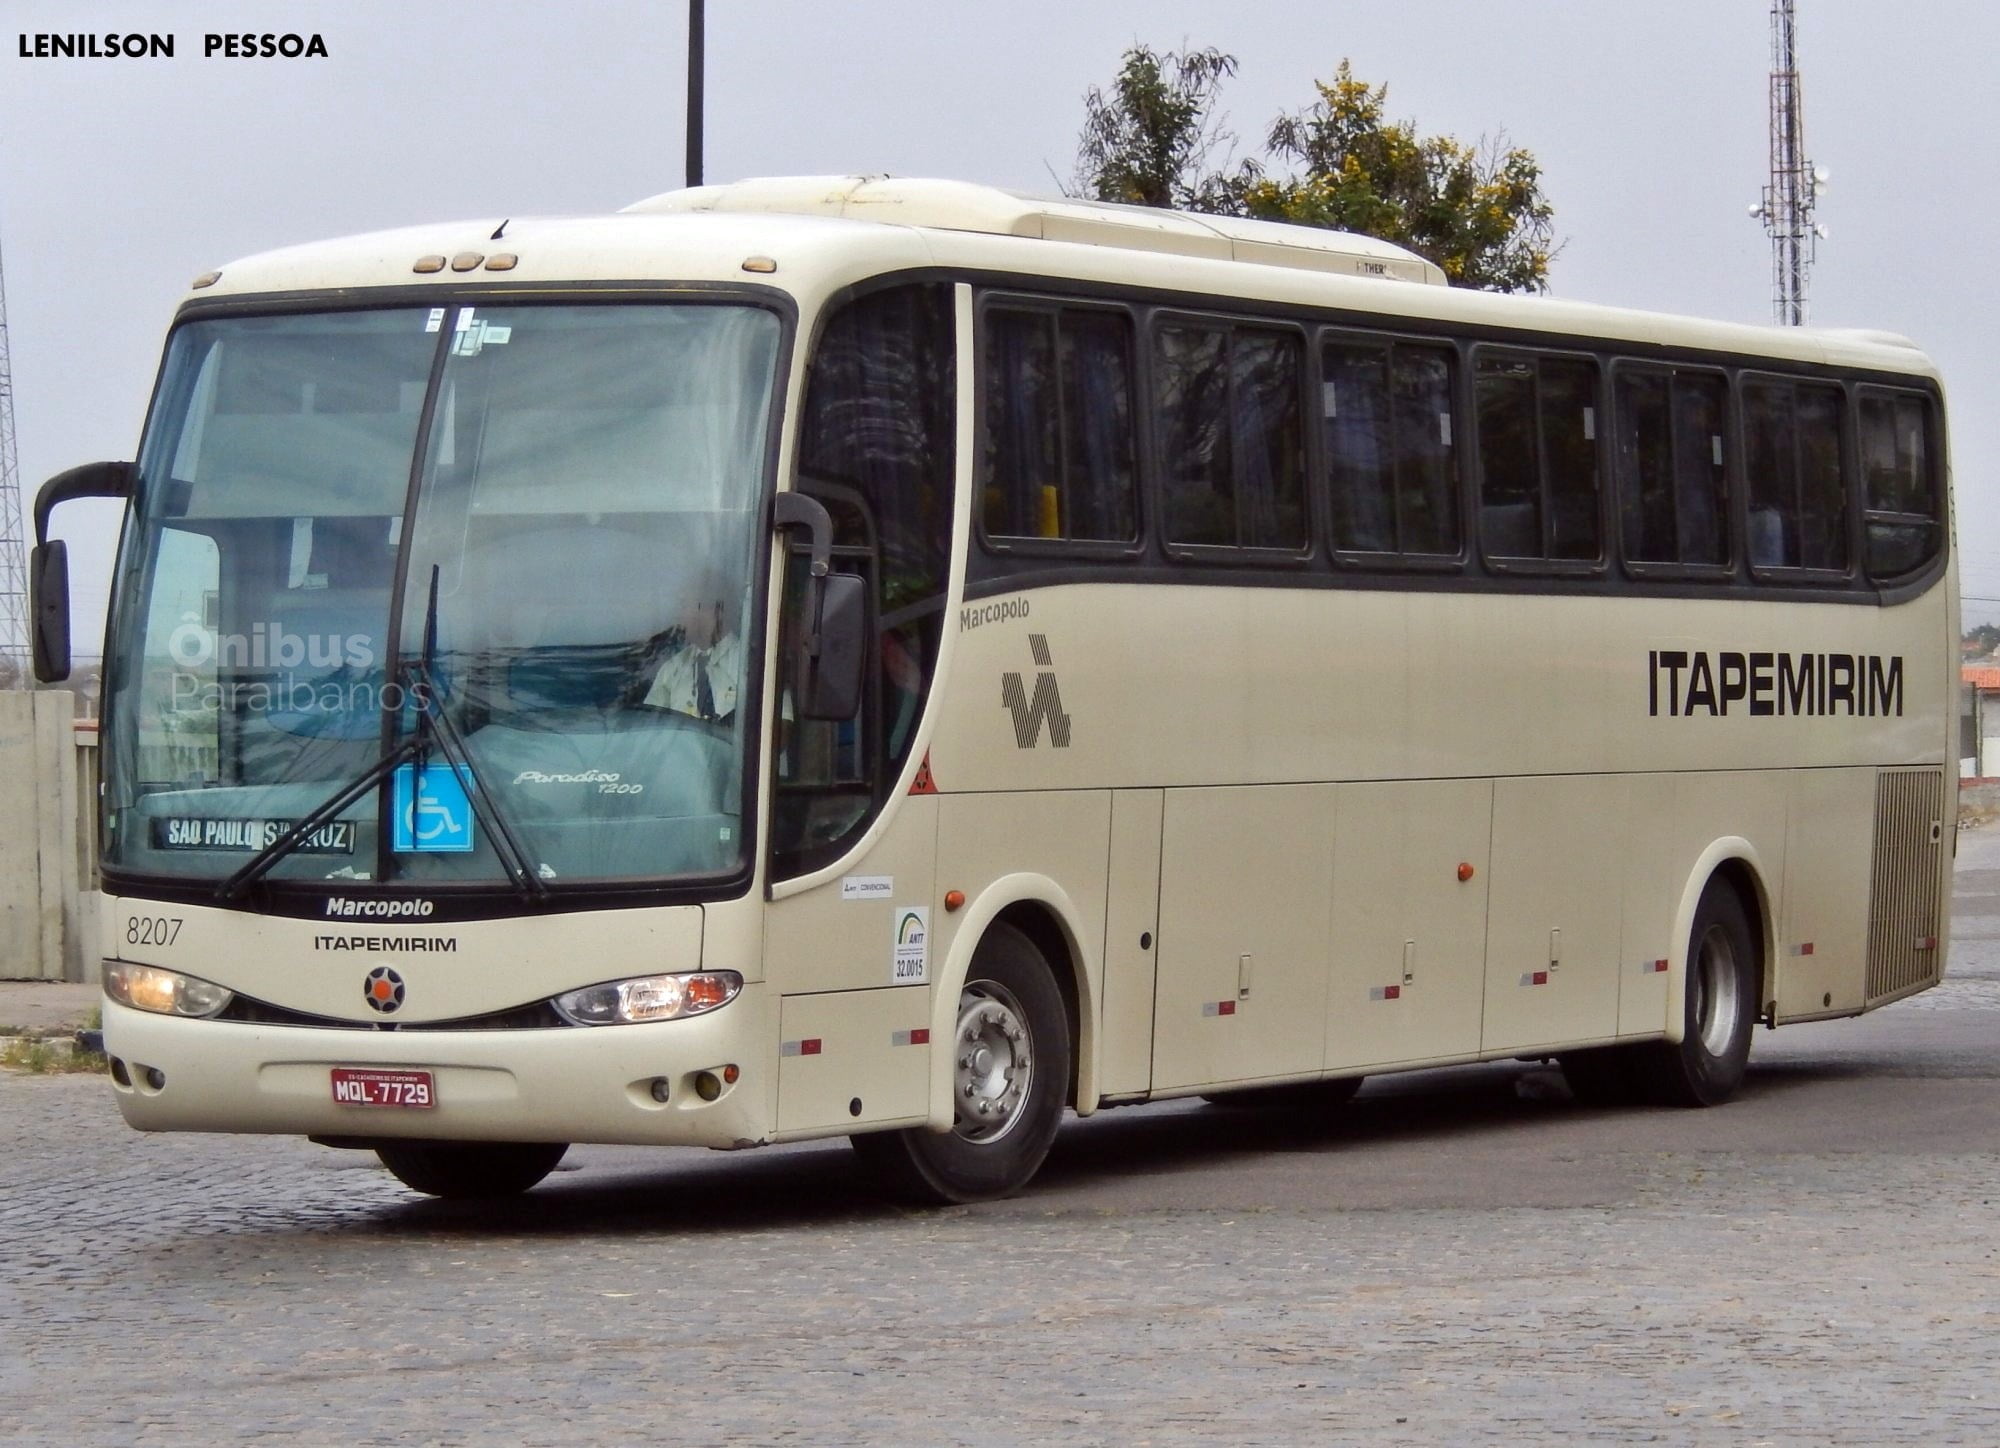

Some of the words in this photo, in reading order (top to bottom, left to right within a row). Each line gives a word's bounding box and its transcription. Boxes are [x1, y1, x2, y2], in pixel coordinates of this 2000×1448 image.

[960, 597, 1029, 632] Marcopolo
[1649, 650, 1903, 717] ITAPEMIRIM
[513, 769, 620, 785] Paradiso
[598, 783, 644, 794] 1200
[326, 898, 433, 917] Marcopolo
[126, 917, 184, 947] 8207
[909, 933, 924, 945] ANTT
[315, 936, 457, 952] ITAPEMIRIM
[897, 959, 923, 978] 32.0015
